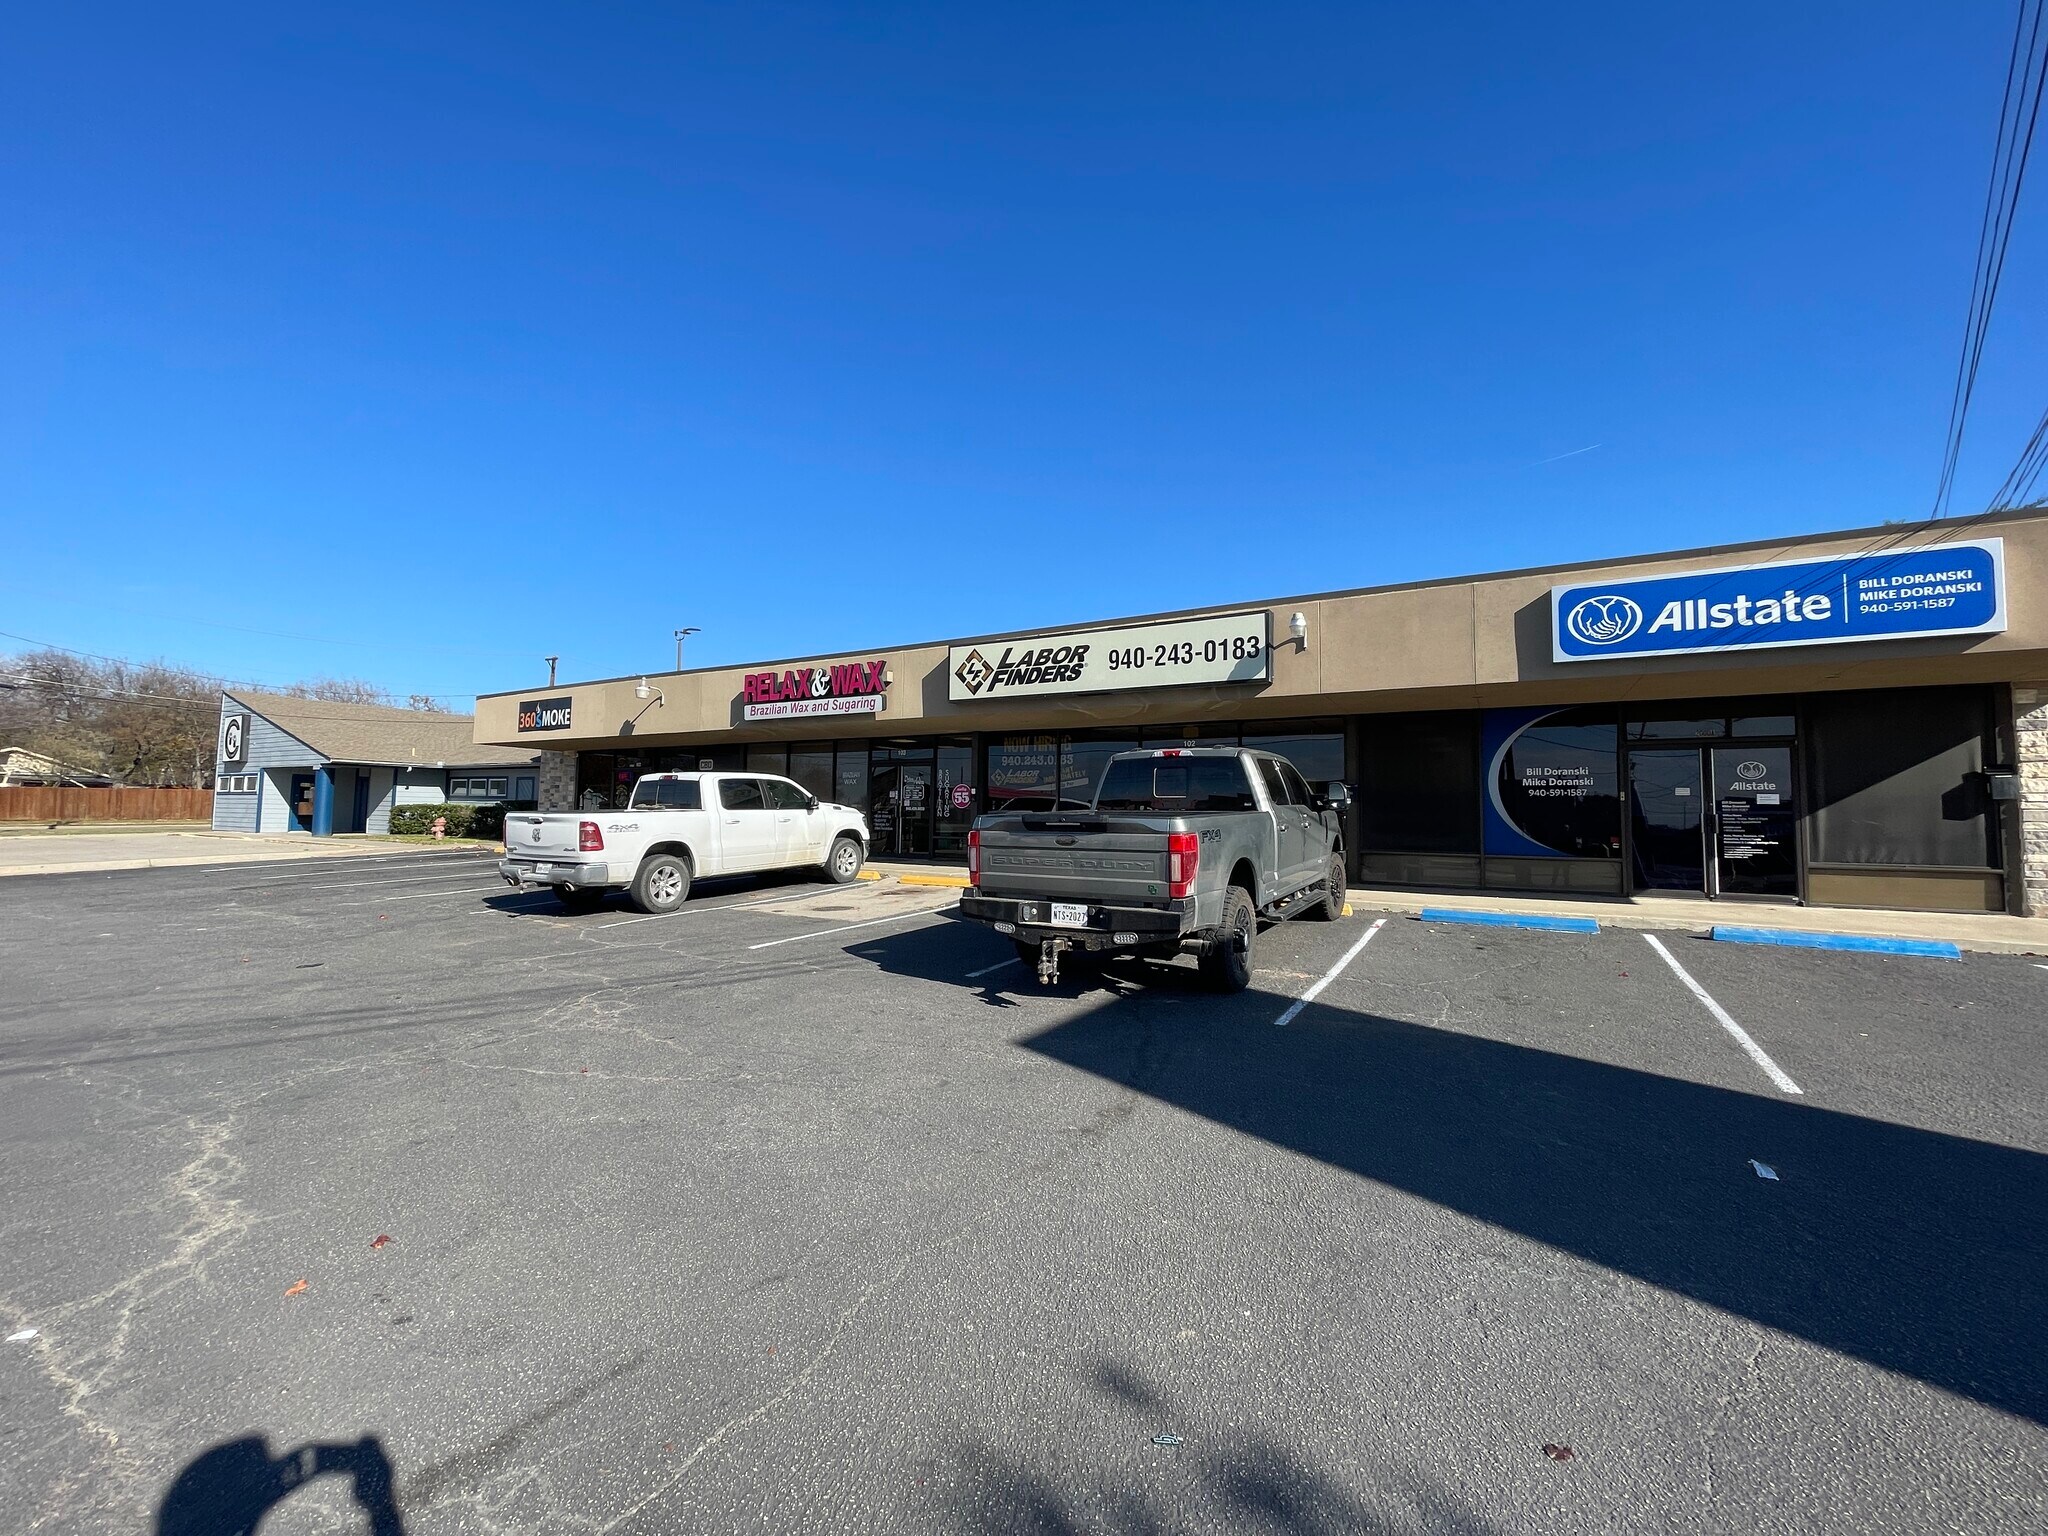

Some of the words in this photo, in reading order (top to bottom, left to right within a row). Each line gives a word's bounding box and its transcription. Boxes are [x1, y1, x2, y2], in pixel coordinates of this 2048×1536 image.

[1859, 577, 1888, 589] BILL
[1891, 569, 1973, 586] DORANSKI
[1859, 589, 1897, 601] MIKE
[1900, 582, 1982, 598] DORANSKI
[1647, 590, 1832, 634] Allstate
[1860, 597, 1956, 614] 940-591-1587
[996, 645, 1090, 670] LABOR
[1108, 636, 1260, 670] 940-243-0183
[986, 663, 1084, 692] FINDERS
[750, 704, 787, 716] Brazilian
[790, 702, 809, 714] Wax
[811, 700, 829, 712] and
[832, 697, 876, 712] Sugaring
[1003, 737, 1029, 753] NOW
[1001, 754, 1074, 766] 940.243.083
[1006, 769, 1040, 777] LABOR
[1526, 767, 1542, 776] Bill
[1544, 766, 1589, 776] Doranski
[1522, 778, 1547, 786] Mike
[1548, 777, 1594, 786] Doranski
[1729, 781, 1777, 791] Allstate
[943, 768, 951, 818] SUGARING
[954, 792, 970, 804] 55
[1200, 829, 1222, 844] FX4
[993, 856, 1073, 867] SUPER
[1080, 859, 1152, 871] DUTY
